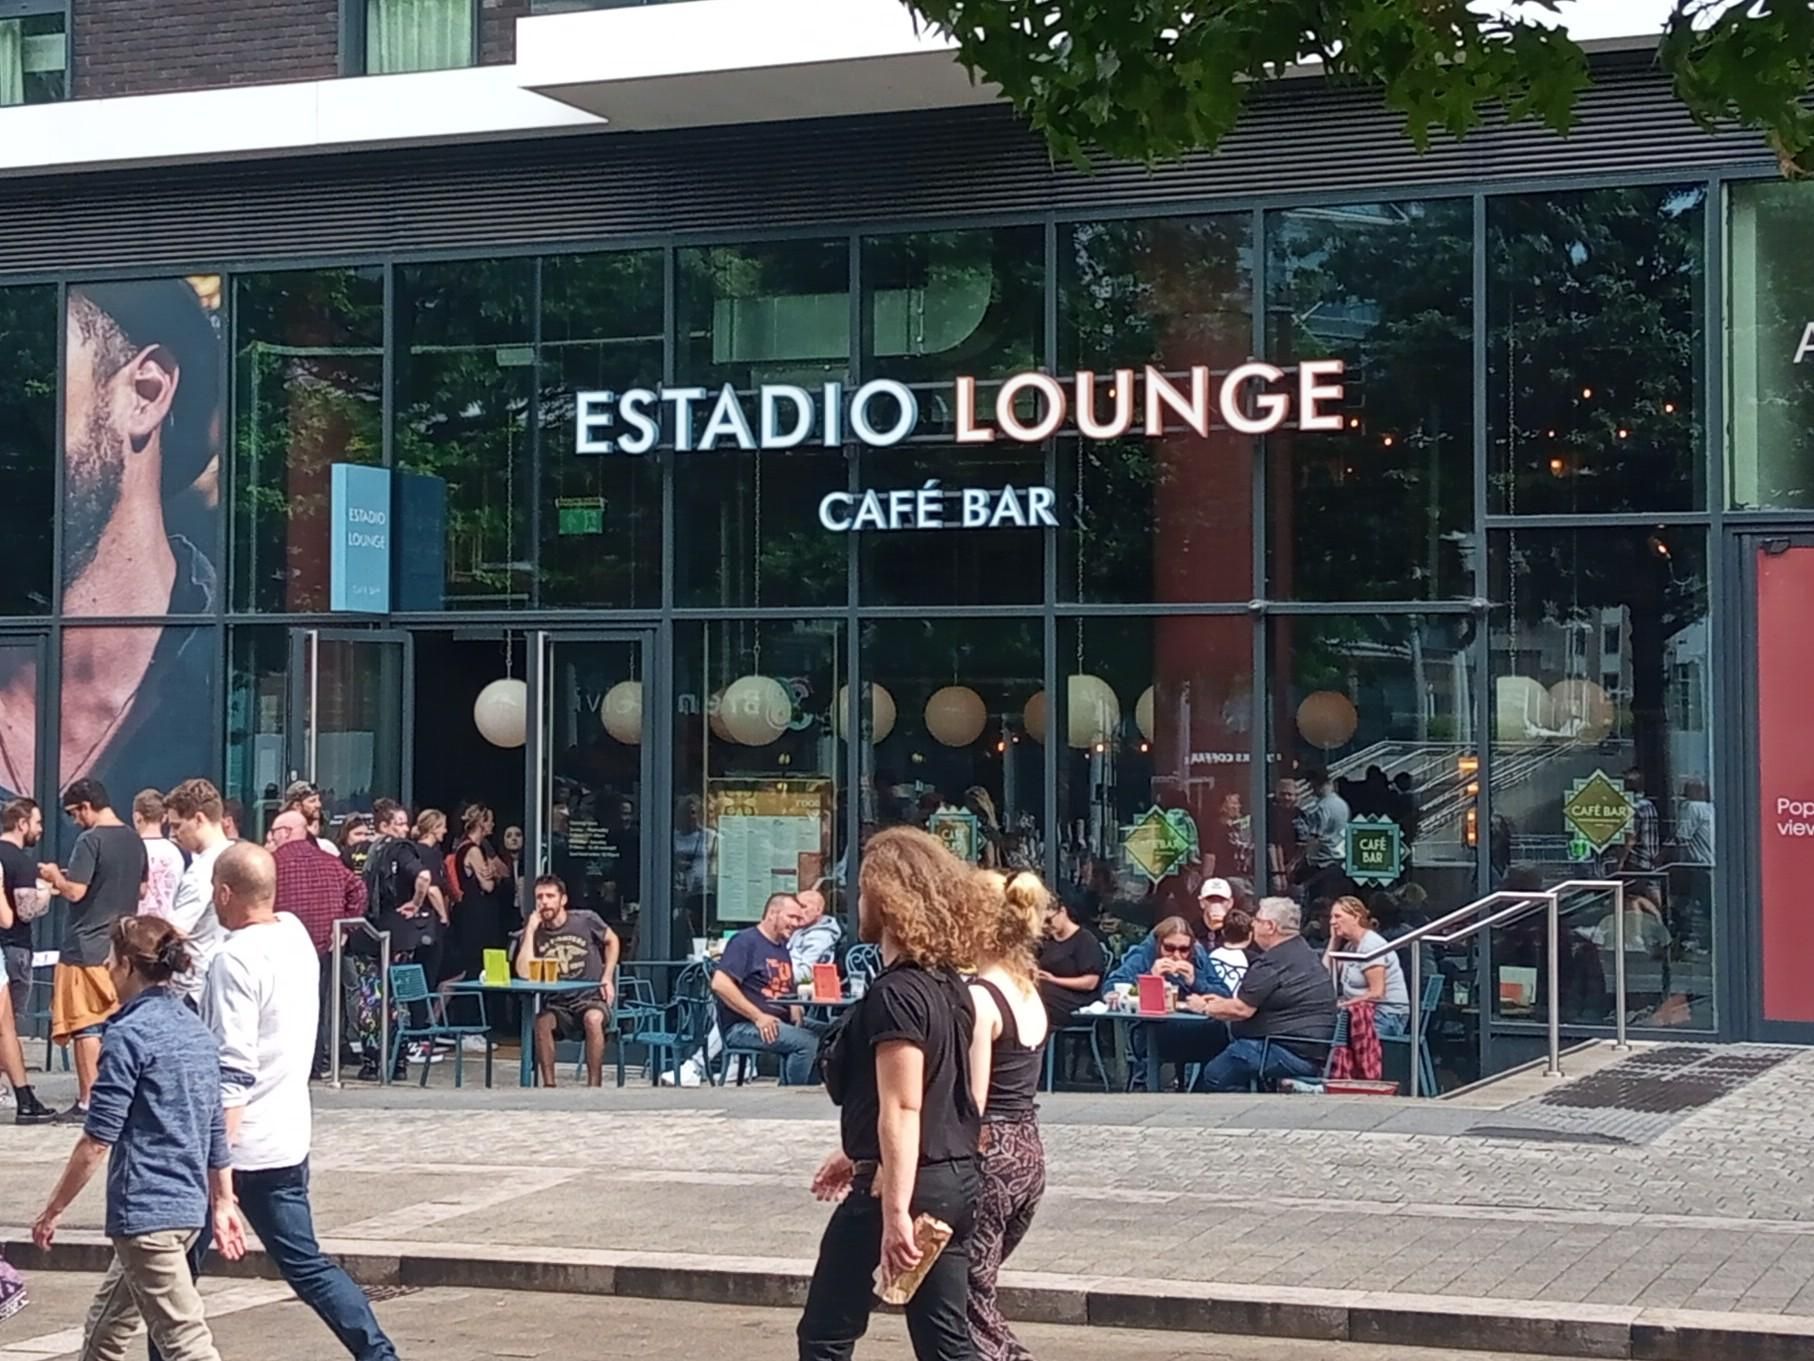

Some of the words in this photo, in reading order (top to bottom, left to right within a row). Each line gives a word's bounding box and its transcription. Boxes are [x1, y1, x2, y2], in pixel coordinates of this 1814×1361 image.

[575, 378, 919, 454] ESTADIO
[955, 359, 1344, 443] LOUNGE
[818, 478, 943, 532] CAFÉ
[962, 483, 1060, 528] BAR
[348, 507, 386, 526] ESTADIO
[347, 531, 385, 550] LOUNGE
[1571, 803, 1601, 817] CAFÉ
[1603, 805, 1627, 817] BAR
[1777, 797, 1814, 819] Pop
[1360, 836, 1387, 851] CAFÉ
[1362, 851, 1383, 863] BAR
